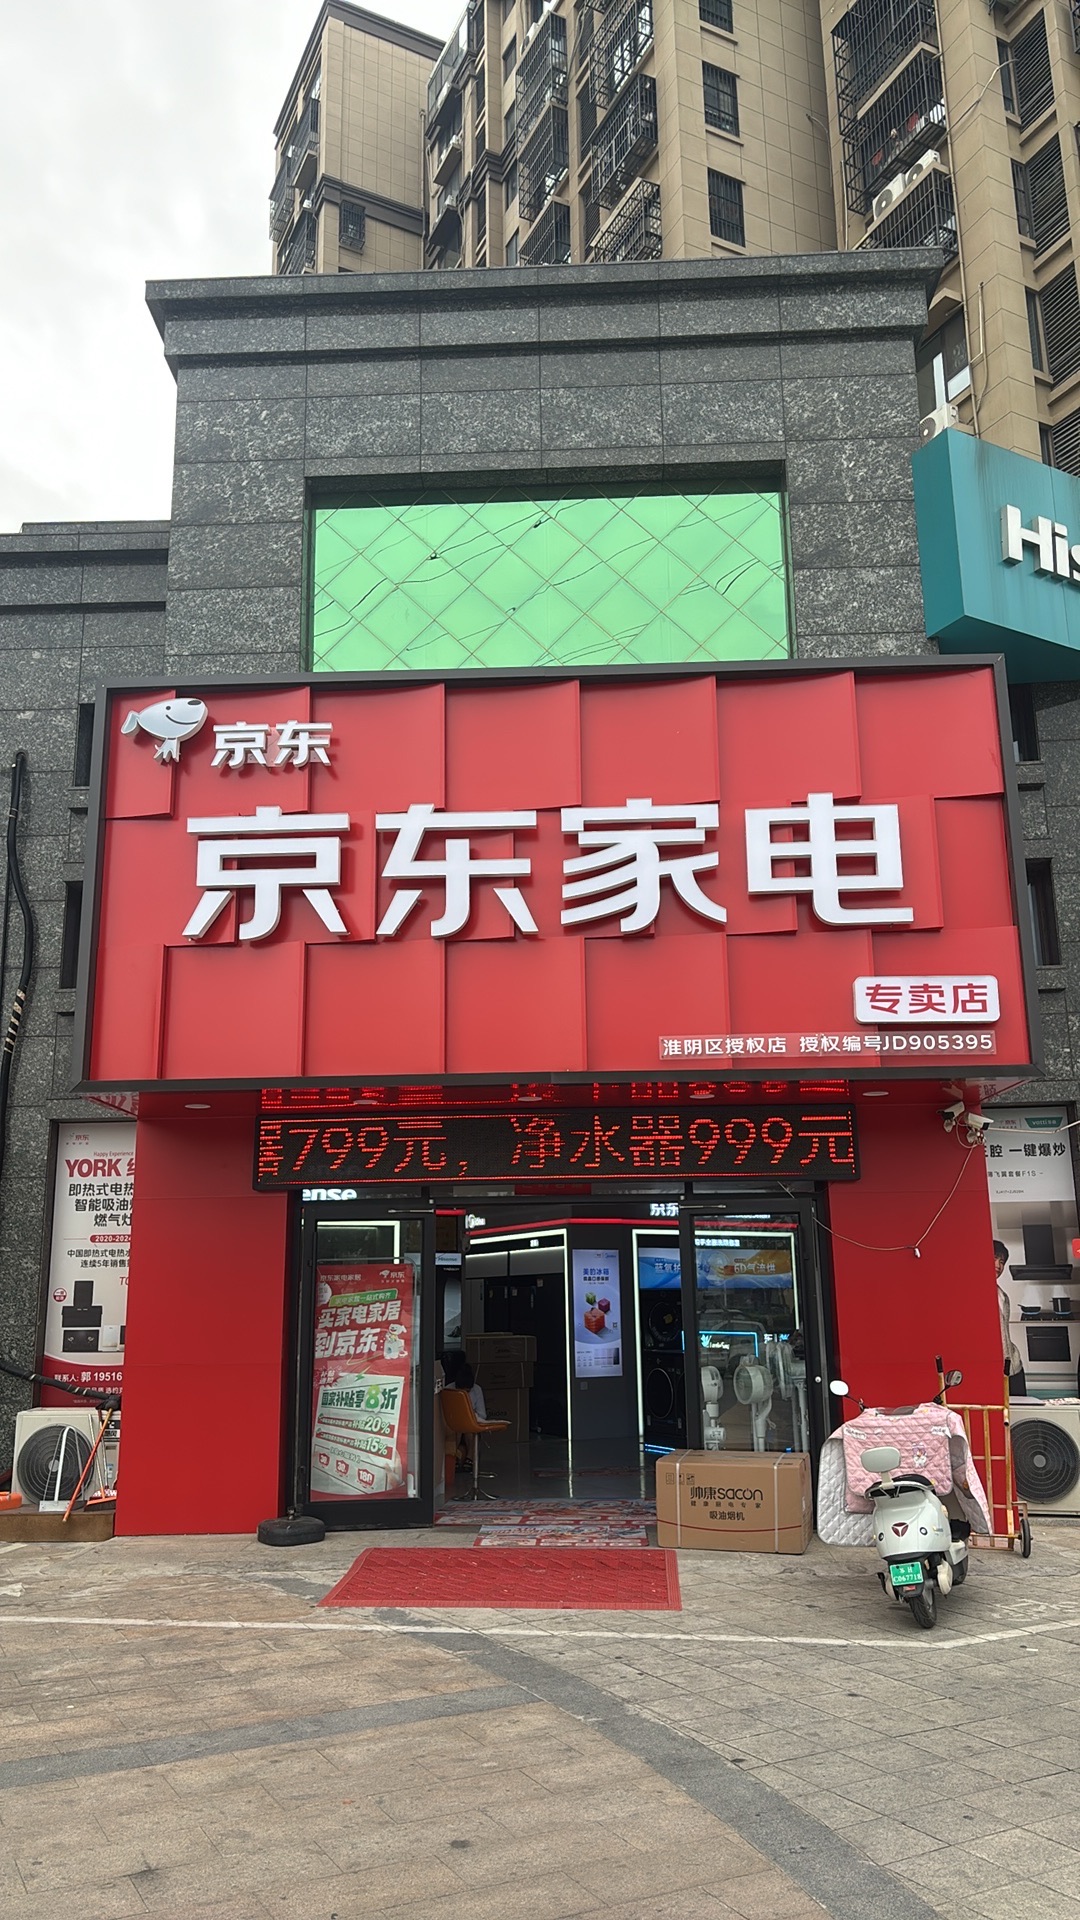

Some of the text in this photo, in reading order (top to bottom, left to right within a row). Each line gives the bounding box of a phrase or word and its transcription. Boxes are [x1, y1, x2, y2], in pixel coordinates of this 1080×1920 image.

[211, 720, 334, 770] 京东
[181, 792, 915, 941] 京东家电
[865, 983, 988, 1015] 专卖店
[663, 1033, 993, 1056] 淮阴区授权店 授权编号JD905395
[984, 1142, 1066, 1158] 腔 一键爆炒
[65, 1158, 122, 1178] YORK
[68, 1182, 134, 1197] 即热式电热
[80, 1259, 130, 1269] 连续5年销售
[318, 1300, 402, 1329] 买家电家居
[314, 1327, 381, 1359] 到京东
[321, 1384, 399, 1411] 国家补贴享8折
[709, 1510, 746, 1521] 吸油烟机
